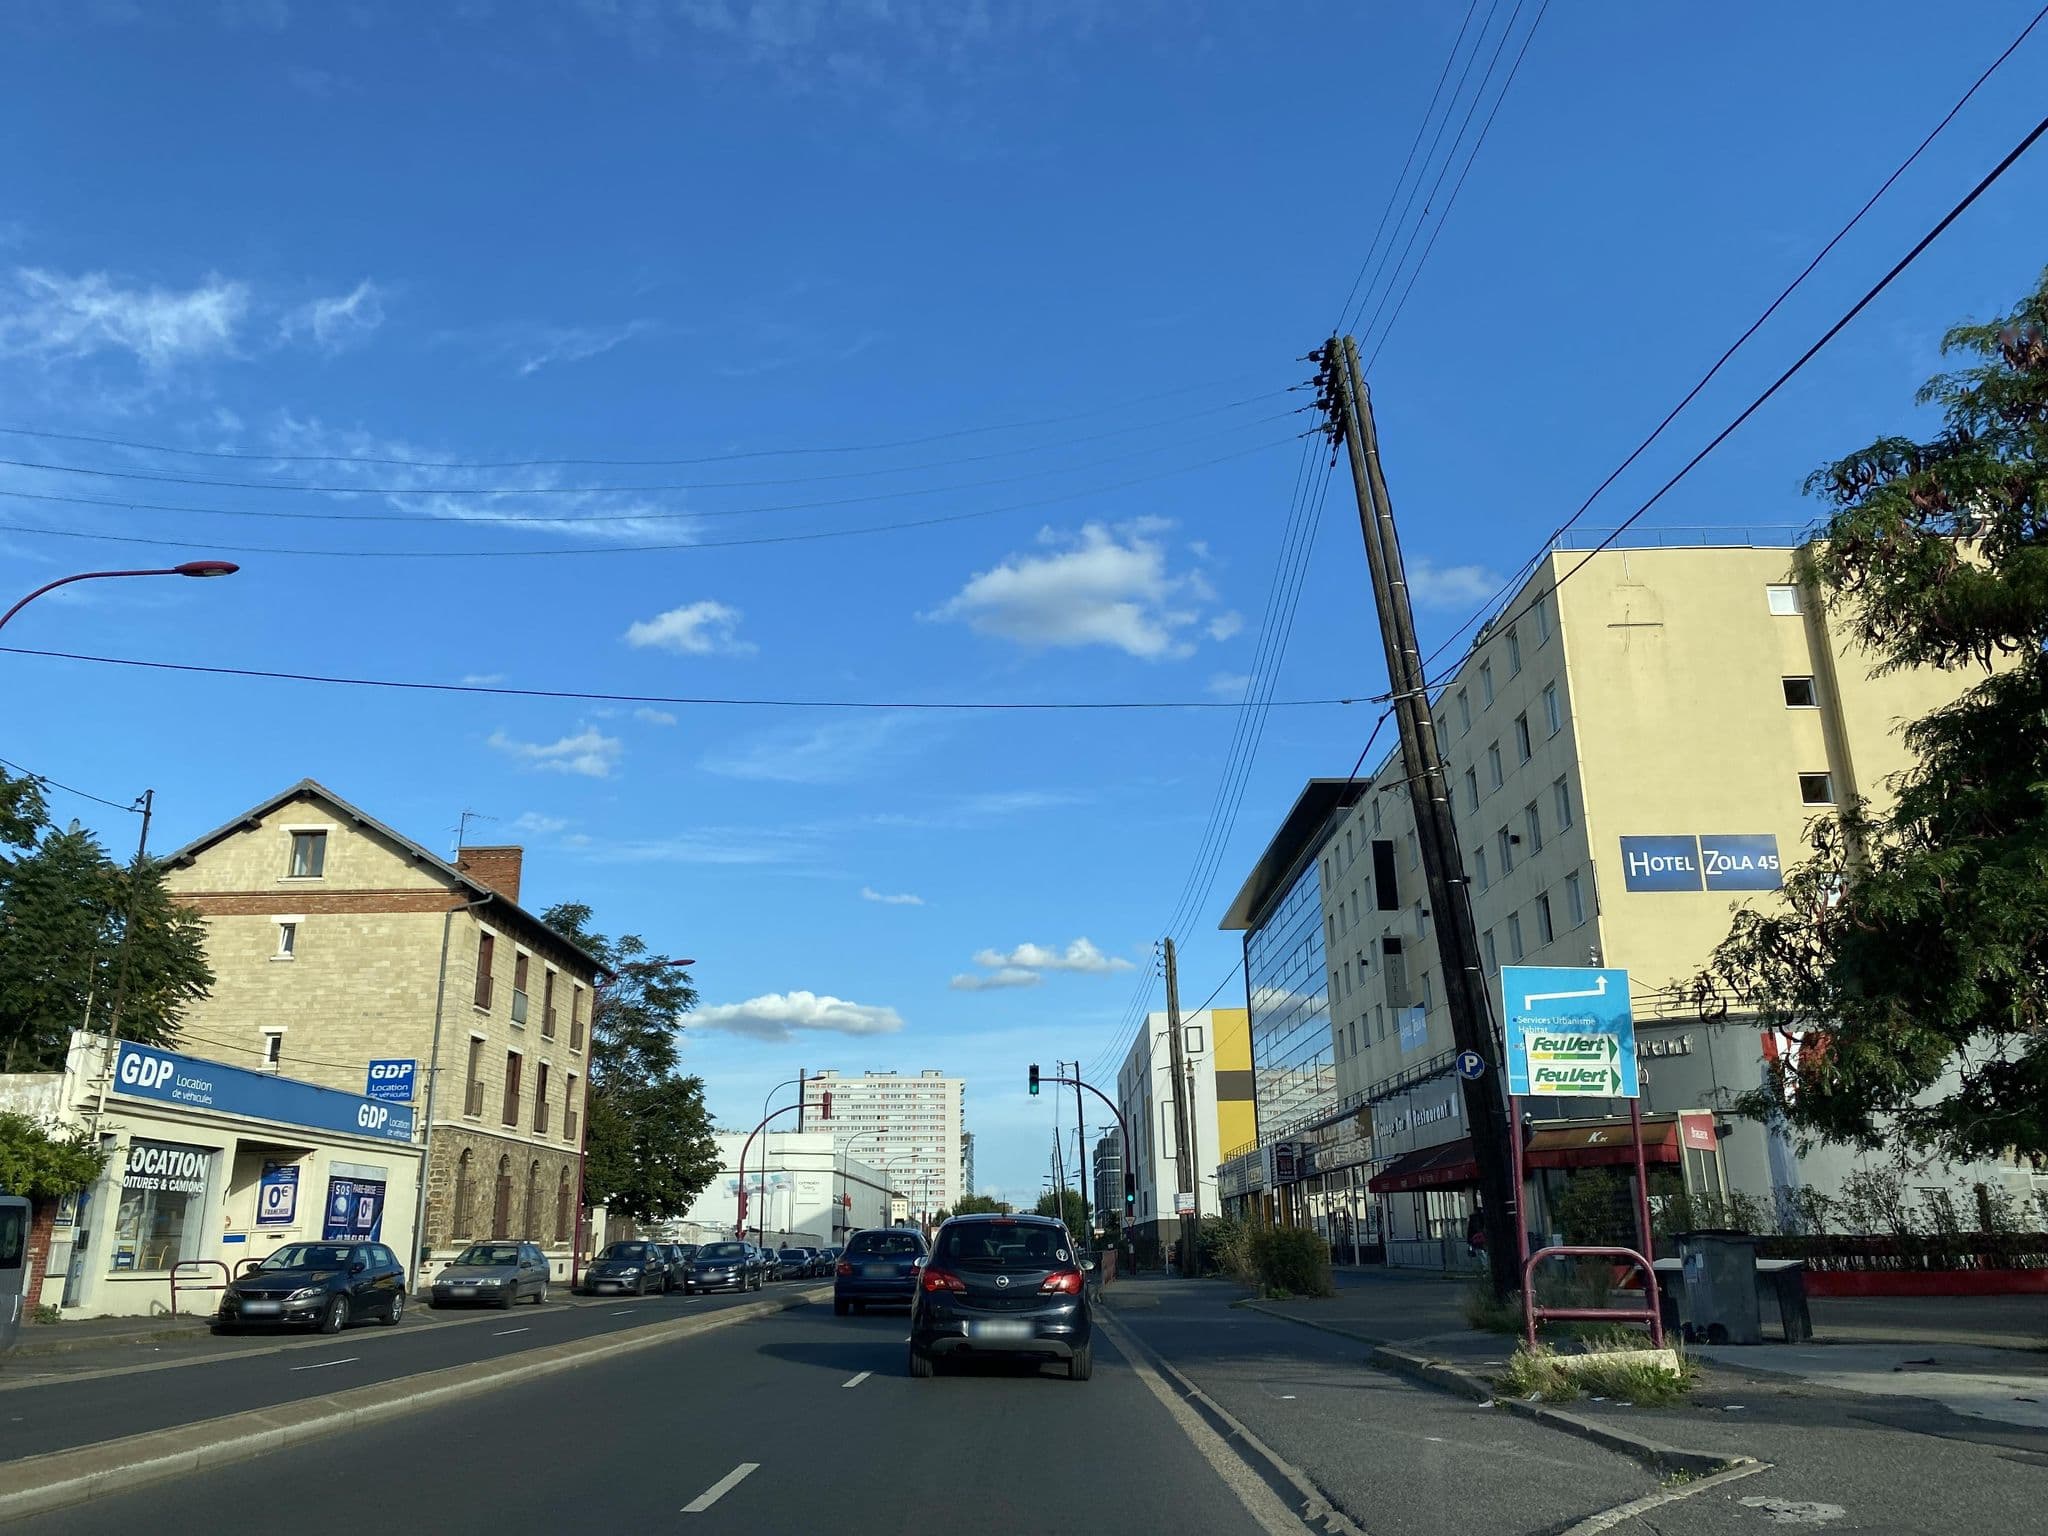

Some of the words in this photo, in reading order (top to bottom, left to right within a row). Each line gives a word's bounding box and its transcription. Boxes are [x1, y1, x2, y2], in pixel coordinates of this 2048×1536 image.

[1628, 851, 1695, 877] HOTEL
[1703, 850, 1754, 875] ZOLA
[1757, 855, 1779, 870] 45
[1517, 1015, 1550, 1024] Services
[1552, 1016, 1596, 1025] Urbanisme
[1518, 1025, 1548, 1033] Habitat
[121, 1053, 174, 1089] GDP
[371, 1064, 413, 1079] GDP
[176, 1074, 213, 1092] Location
[371, 1083, 409, 1092] Location
[171, 1088, 181, 1099] de
[358, 1104, 388, 1130] GDP
[160, 1179, 168, 1190] &
[168, 1180, 205, 1193] CAMIONS
